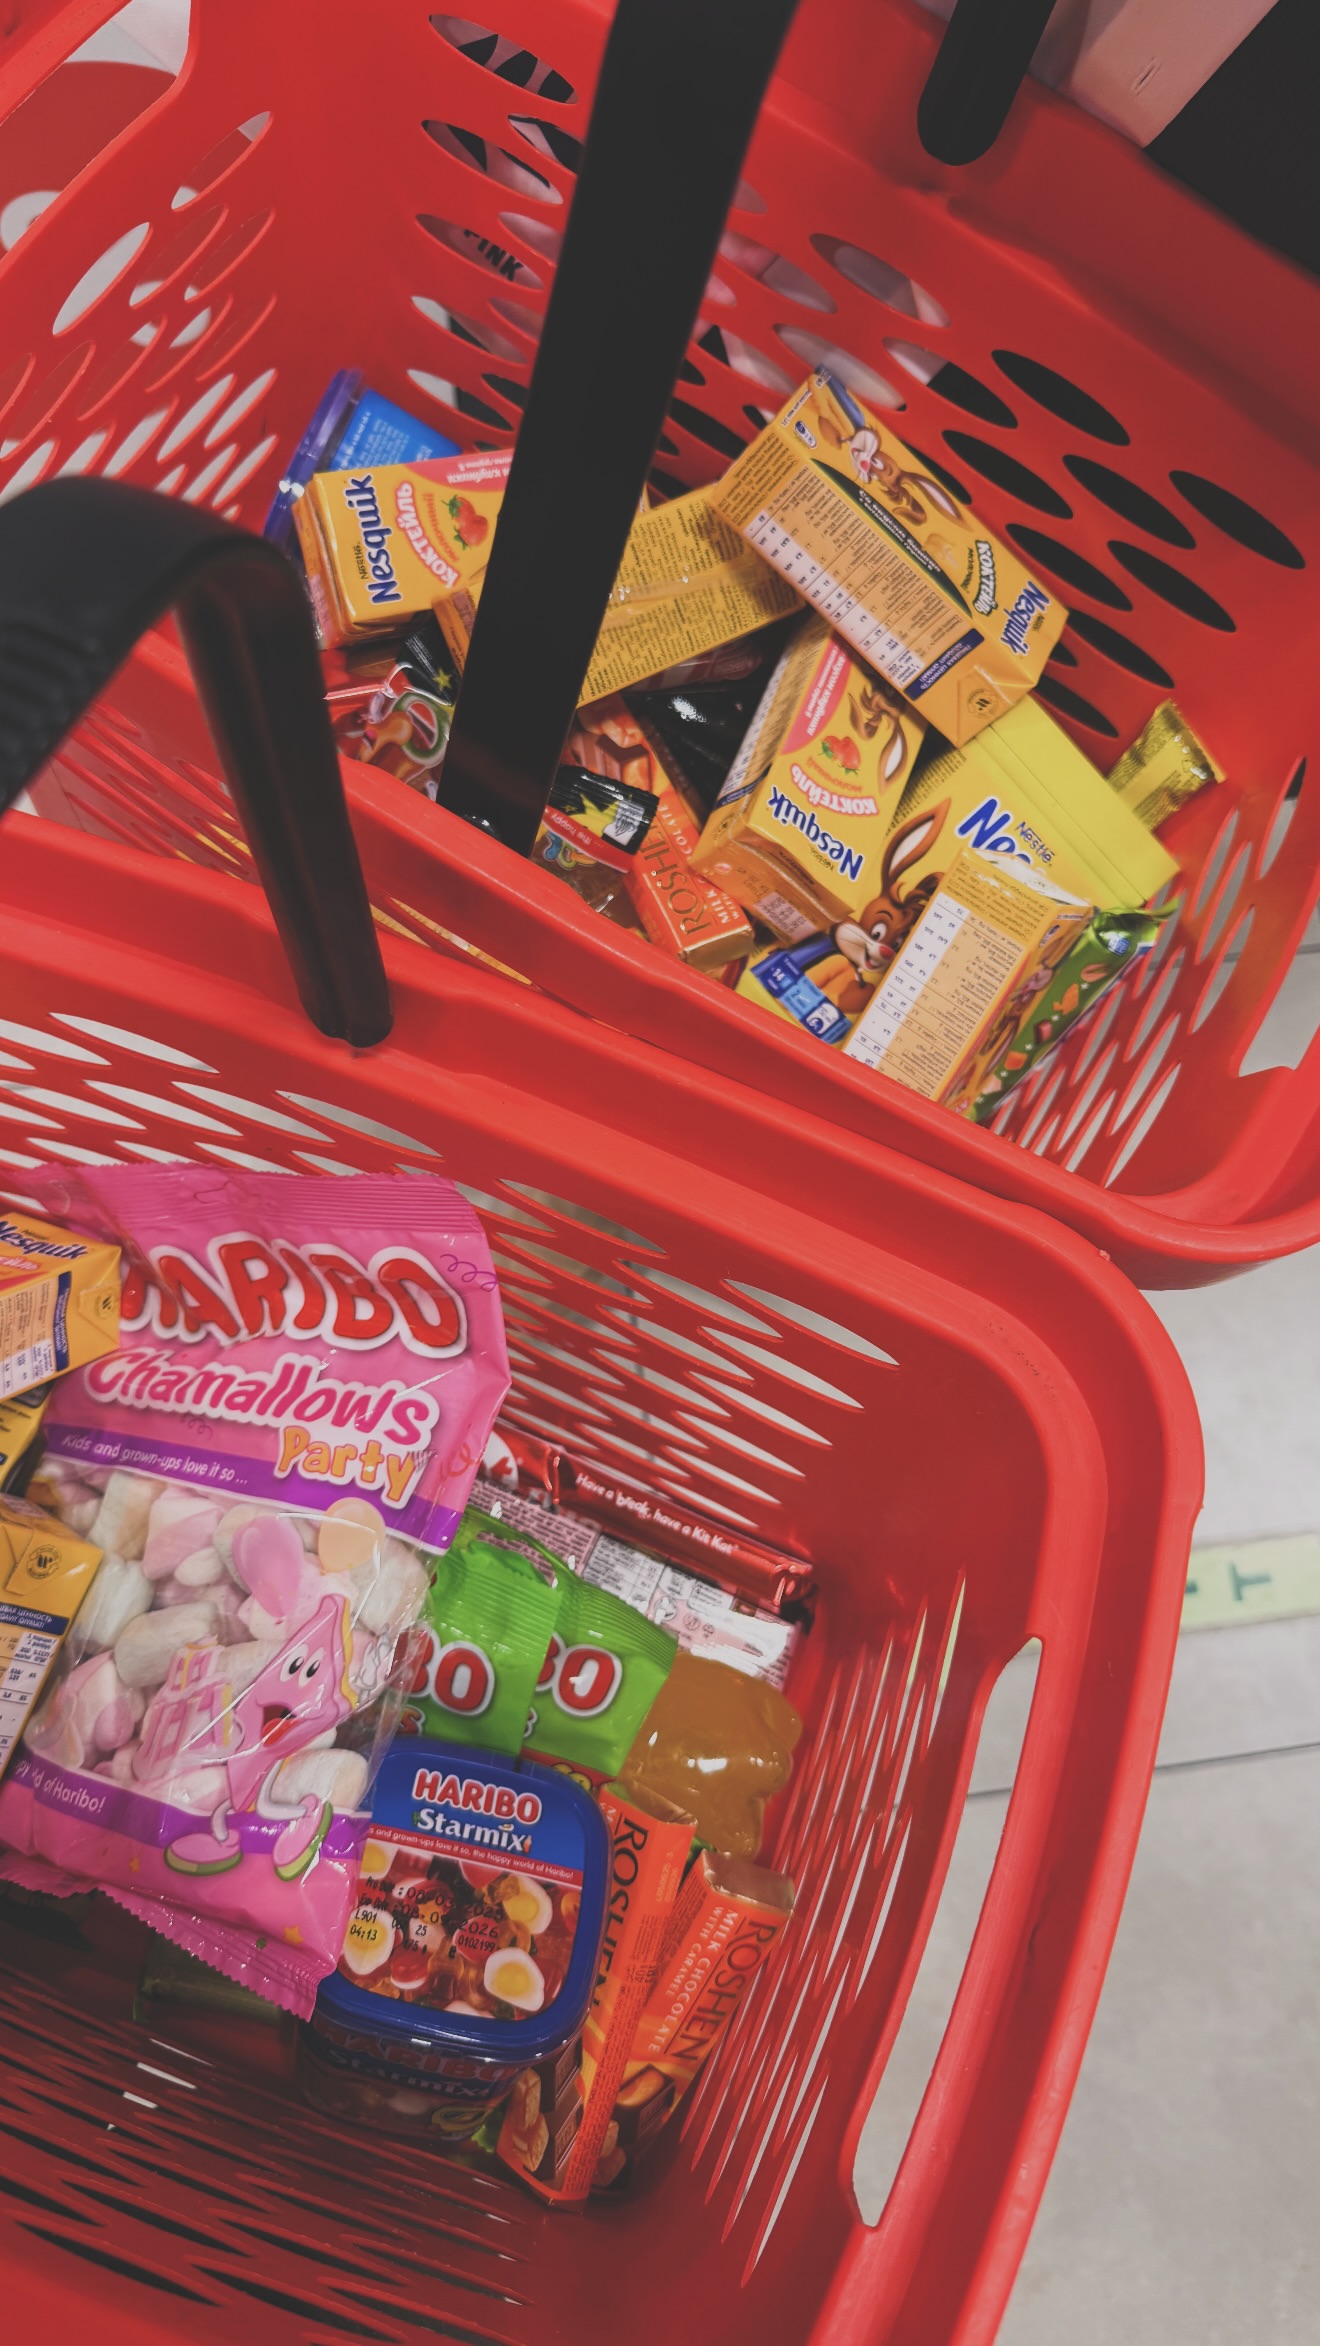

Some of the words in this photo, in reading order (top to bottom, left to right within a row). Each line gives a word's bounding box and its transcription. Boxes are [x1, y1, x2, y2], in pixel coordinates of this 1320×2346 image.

[345, 475, 402, 604] Nesquik
[395, 481, 458, 588] КОКТЕЙЛЬ
[973, 541, 996, 615] КОКТЕЙЛЬ
[999, 581, 1050, 653] Nesquik
[791, 764, 878, 816] КОКТЕЙЛЬ
[769, 786, 863, 881] Nesquik
[704, 887, 730, 924] MILK
[88, 1352, 430, 1445] Chamallows
[63, 1433, 92, 1453] Kids
[95, 1443, 119, 1460] and
[122, 1449, 182, 1471] grown-ups
[184, 1457, 206, 1476] love
[208, 1464, 216, 1477] it
[219, 1467, 235, 1480] so
[278, 1426, 414, 1502] Party
[574, 1472, 607, 1497] Have
[603, 1488, 615, 1501] a
[651, 1507, 683, 1532] have
[680, 1522, 693, 1536] a
[690, 1524, 713, 1545] Kit
[53, 1781, 104, 1813] Haribo!
[413, 1770, 540, 1824] HARIBO
[375, 1825, 392, 1838] and
[391, 1829, 435, 1849] grown-ups
[434, 1838, 453, 1851] love
[452, 1842, 459, 1852] it
[459, 1846, 472, 1857] so,
[472, 1848, 486, 1859] the
[485, 1852, 512, 1868] happy
[512, 1857, 535, 1871] world
[535, 1862, 544, 1873] of
[543, 1865, 574, 1880] Haribo!
[417, 1807, 529, 1853] Starmix
[348, 1924, 378, 1941] 04:13
[414, 1923, 428, 1937] 25
[697, 1903, 724, 1940] WITH
[705, 1907, 738, 1953] MILK
[664, 1941, 703, 1998] CARAMEL
[669, 1919, 777, 2061] ROSHEN
[646, 1955, 712, 2055] CHOCOLATE
